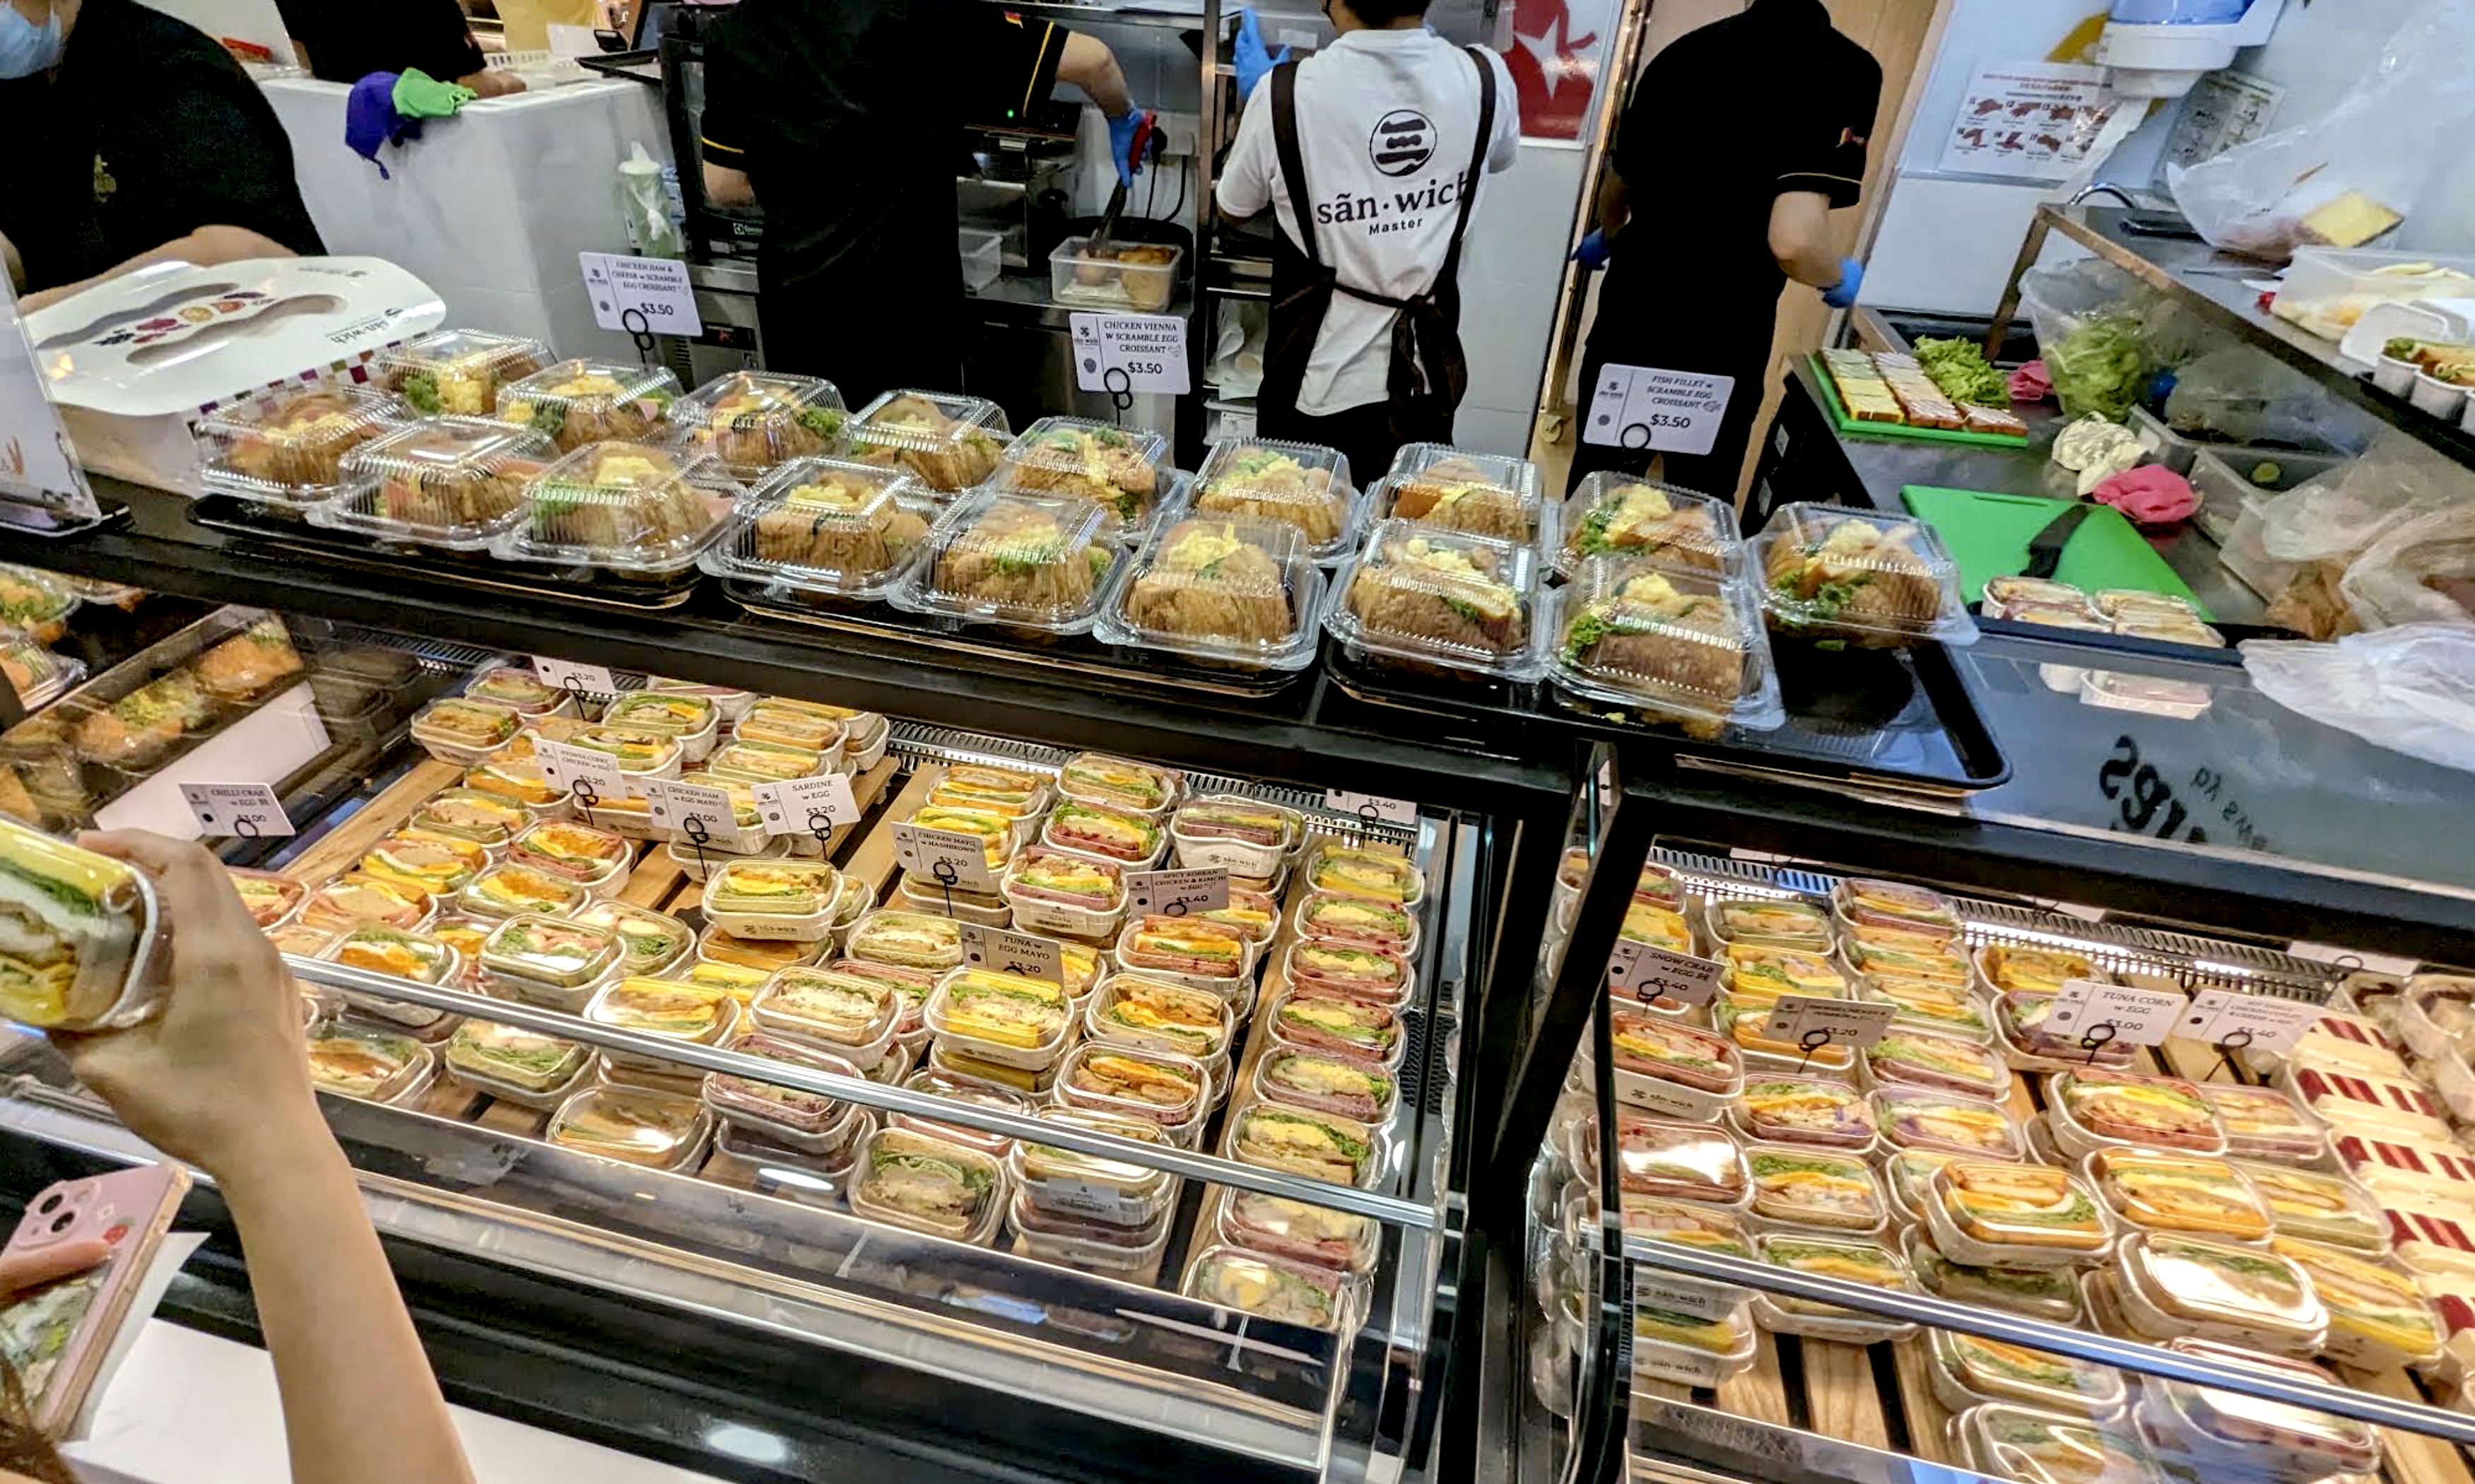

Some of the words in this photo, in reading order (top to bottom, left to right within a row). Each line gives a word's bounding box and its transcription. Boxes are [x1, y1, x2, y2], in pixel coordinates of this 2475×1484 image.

[1369, 218, 1423, 235] Master
[646, 274, 683, 283] SCRAMBLE
[638, 283, 676, 292] CROISSANT
[640, 302, 674, 315] $3.50
[1104, 322, 1141, 330] CHICKEN
[1144, 323, 1177, 331] VIENNA
[1116, 334, 1160, 342] SCRAMBLE
[1119, 344, 1166, 353] CROISSANT
[1128, 363, 1163, 375] $3.50
[1652, 376, 1672, 384] FISH
[1674, 377, 1705, 387] FILLET
[1647, 386, 1692, 397] SCRAMBLE
[1693, 390, 1712, 399] EGG
[1652, 397, 1700, 408] CROISSANT
[1650, 414, 1691, 428] $3.50
[562, 758, 590, 767] CHICKEN
[792, 780, 833, 791] SARDINE
[668, 787, 700, 796] CHICKEN
[811, 791, 830, 799] EGG
[806, 805, 836, 815] $3.20
[919, 832, 952, 842] CHICKEN
[928, 842, 976, 853] HASHBROWN
[939, 856, 968, 866] $3.20
[1176, 895, 1209, 905] $3.40
[1004, 935, 1031, 948] TUNA
[999, 944, 1018, 953] EGG
[1021, 947, 1050, 960] MAYO
[1650, 952, 1685, 964] SNOW
[1685, 961, 1715, 973] CRAB
[2103, 991, 2135, 1002] TUNA
[2138, 996, 2175, 1006] CORN
[2125, 1006, 2151, 1014] EGG
[2105, 1019, 2143, 1030] $3.00
